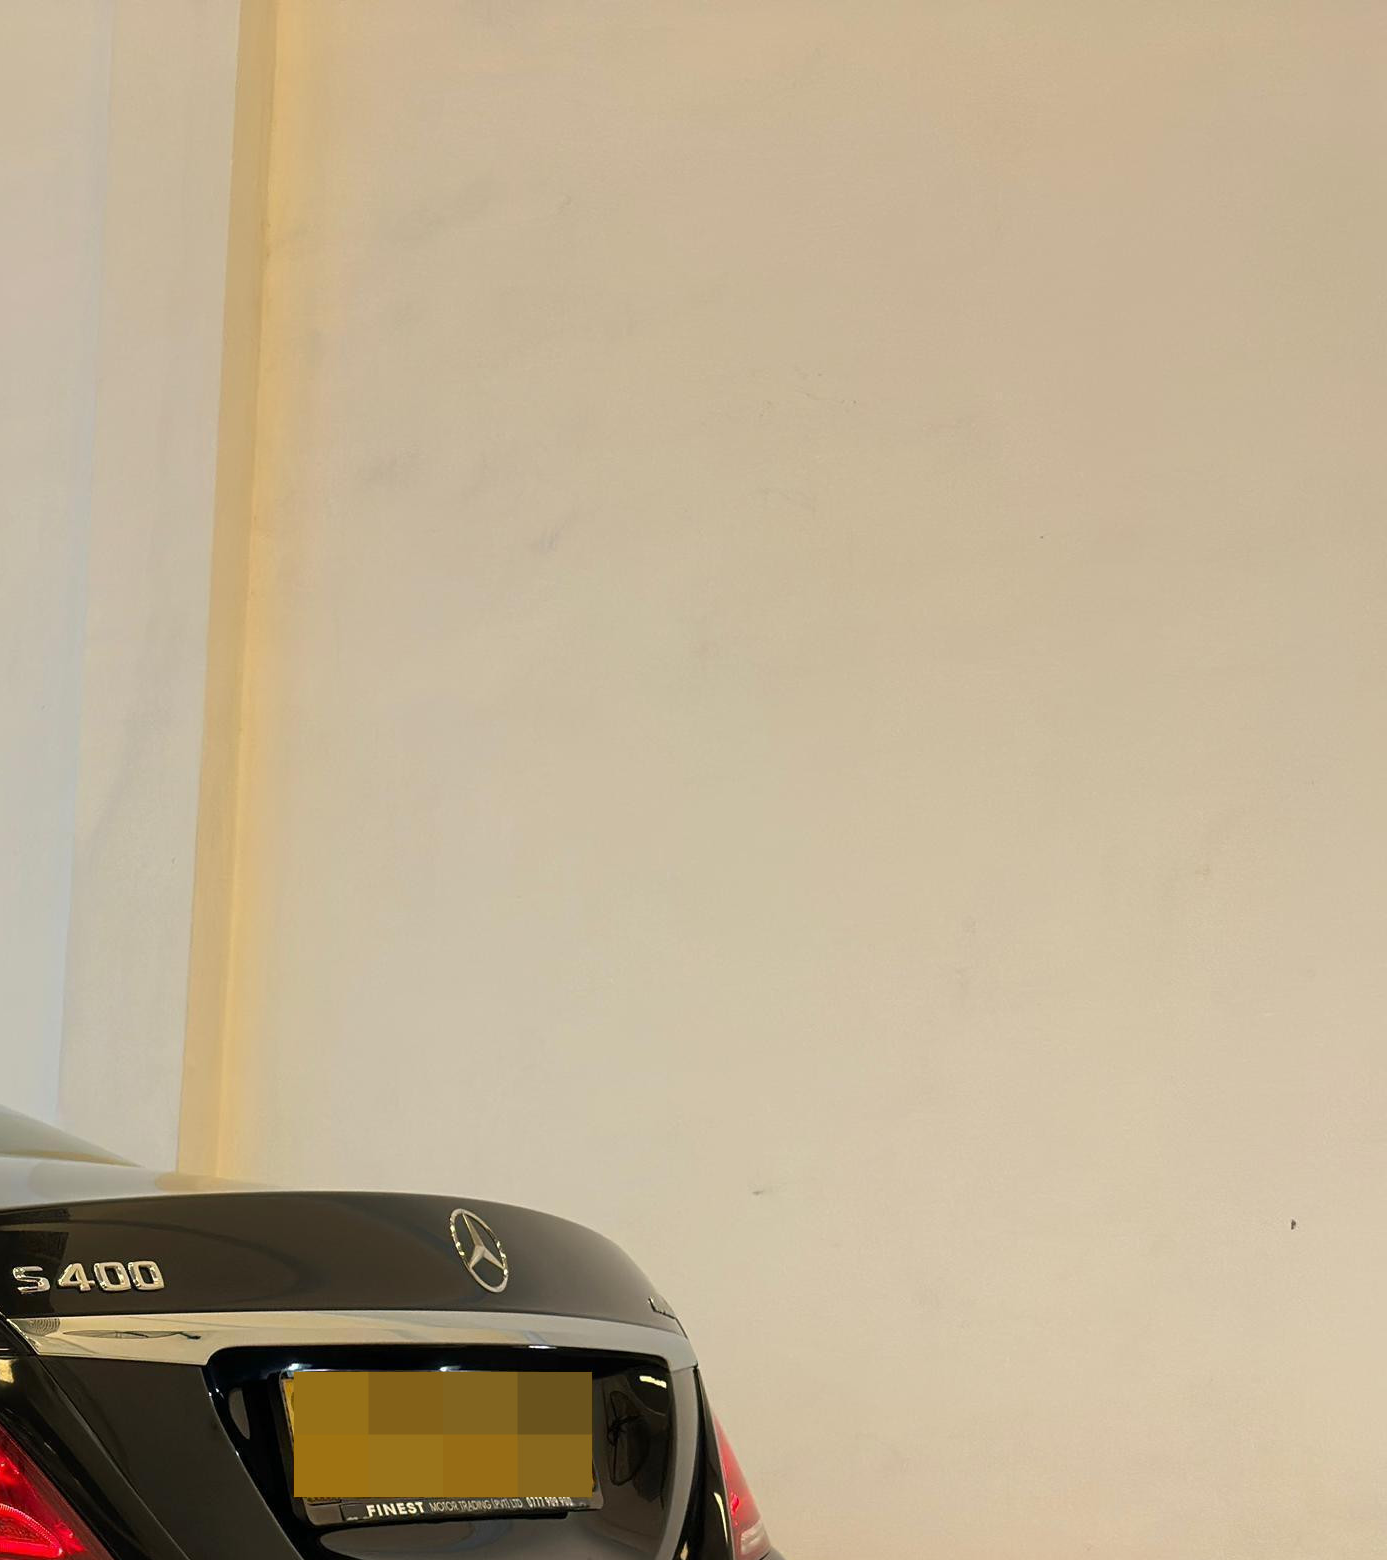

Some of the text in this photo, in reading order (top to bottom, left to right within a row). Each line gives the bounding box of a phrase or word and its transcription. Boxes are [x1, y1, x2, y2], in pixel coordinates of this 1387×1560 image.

[365, 1500, 426, 1519] FINEST
[428, 1500, 459, 1513] MOTOR
[458, 1499, 492, 1512] TRADING
